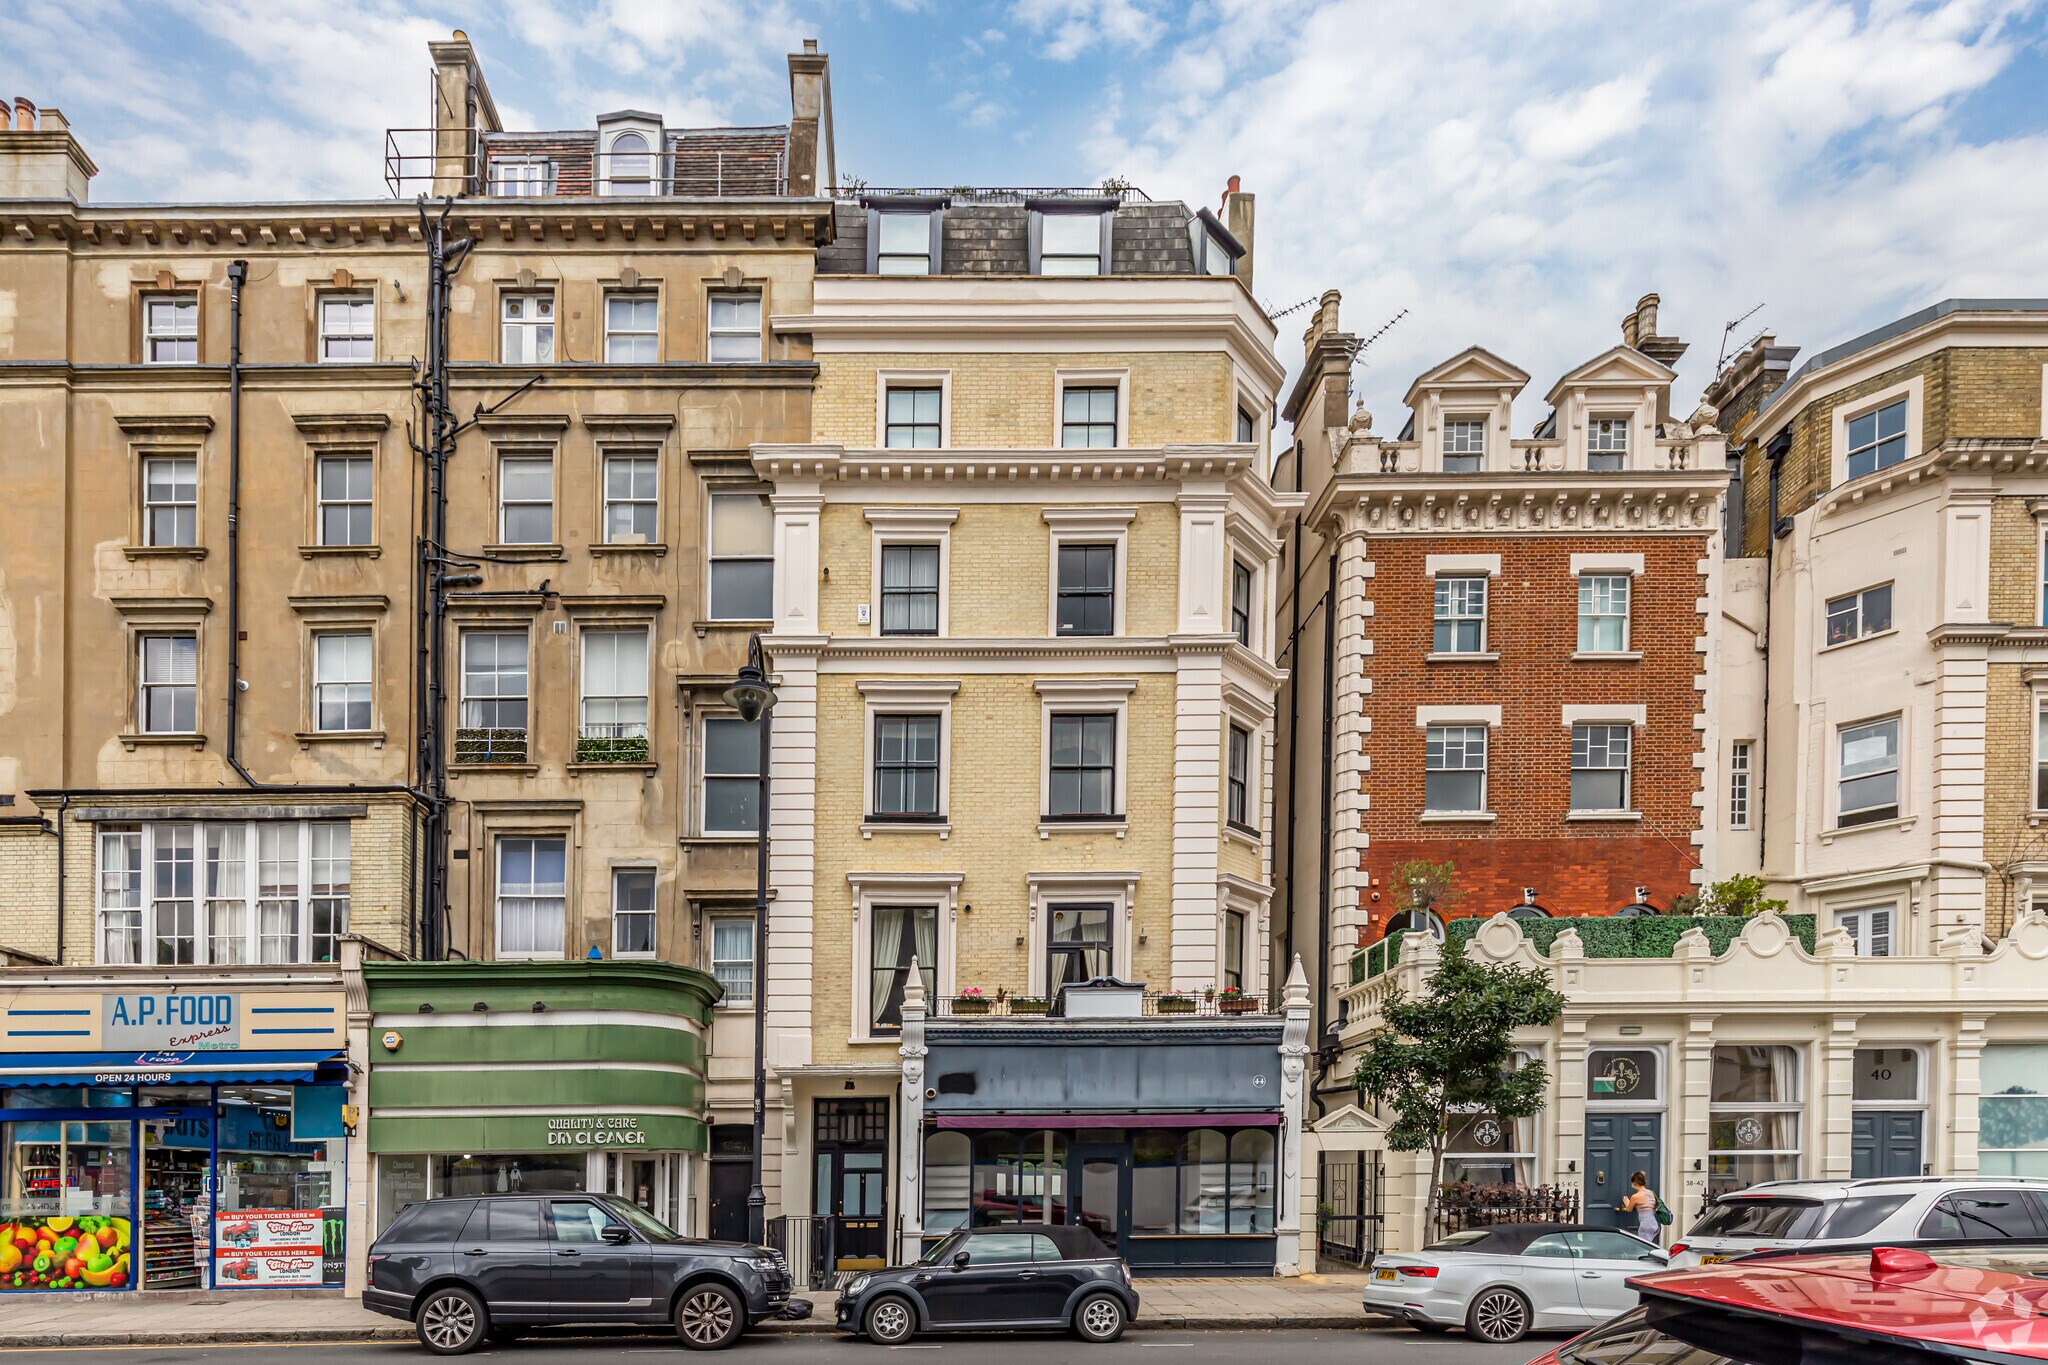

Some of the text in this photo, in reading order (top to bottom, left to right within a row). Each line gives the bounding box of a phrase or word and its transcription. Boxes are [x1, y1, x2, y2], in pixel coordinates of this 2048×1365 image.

[111, 995, 232, 1026] A.P.FOOD
[169, 1025, 231, 1047] Express
[198, 1042, 239, 1050] Metro
[95, 1073, 171, 1082] OPEN 24 HOURS
[1870, 1069, 1892, 1081] 40
[548, 1117, 637, 1129] QUALITY & CARE
[547, 1131, 645, 1145] DRY CLEANER
[267, 1221, 314, 1233] City Tour
[266, 1258, 314, 1270] City Tour
[323, 1261, 345, 1269] ONST
